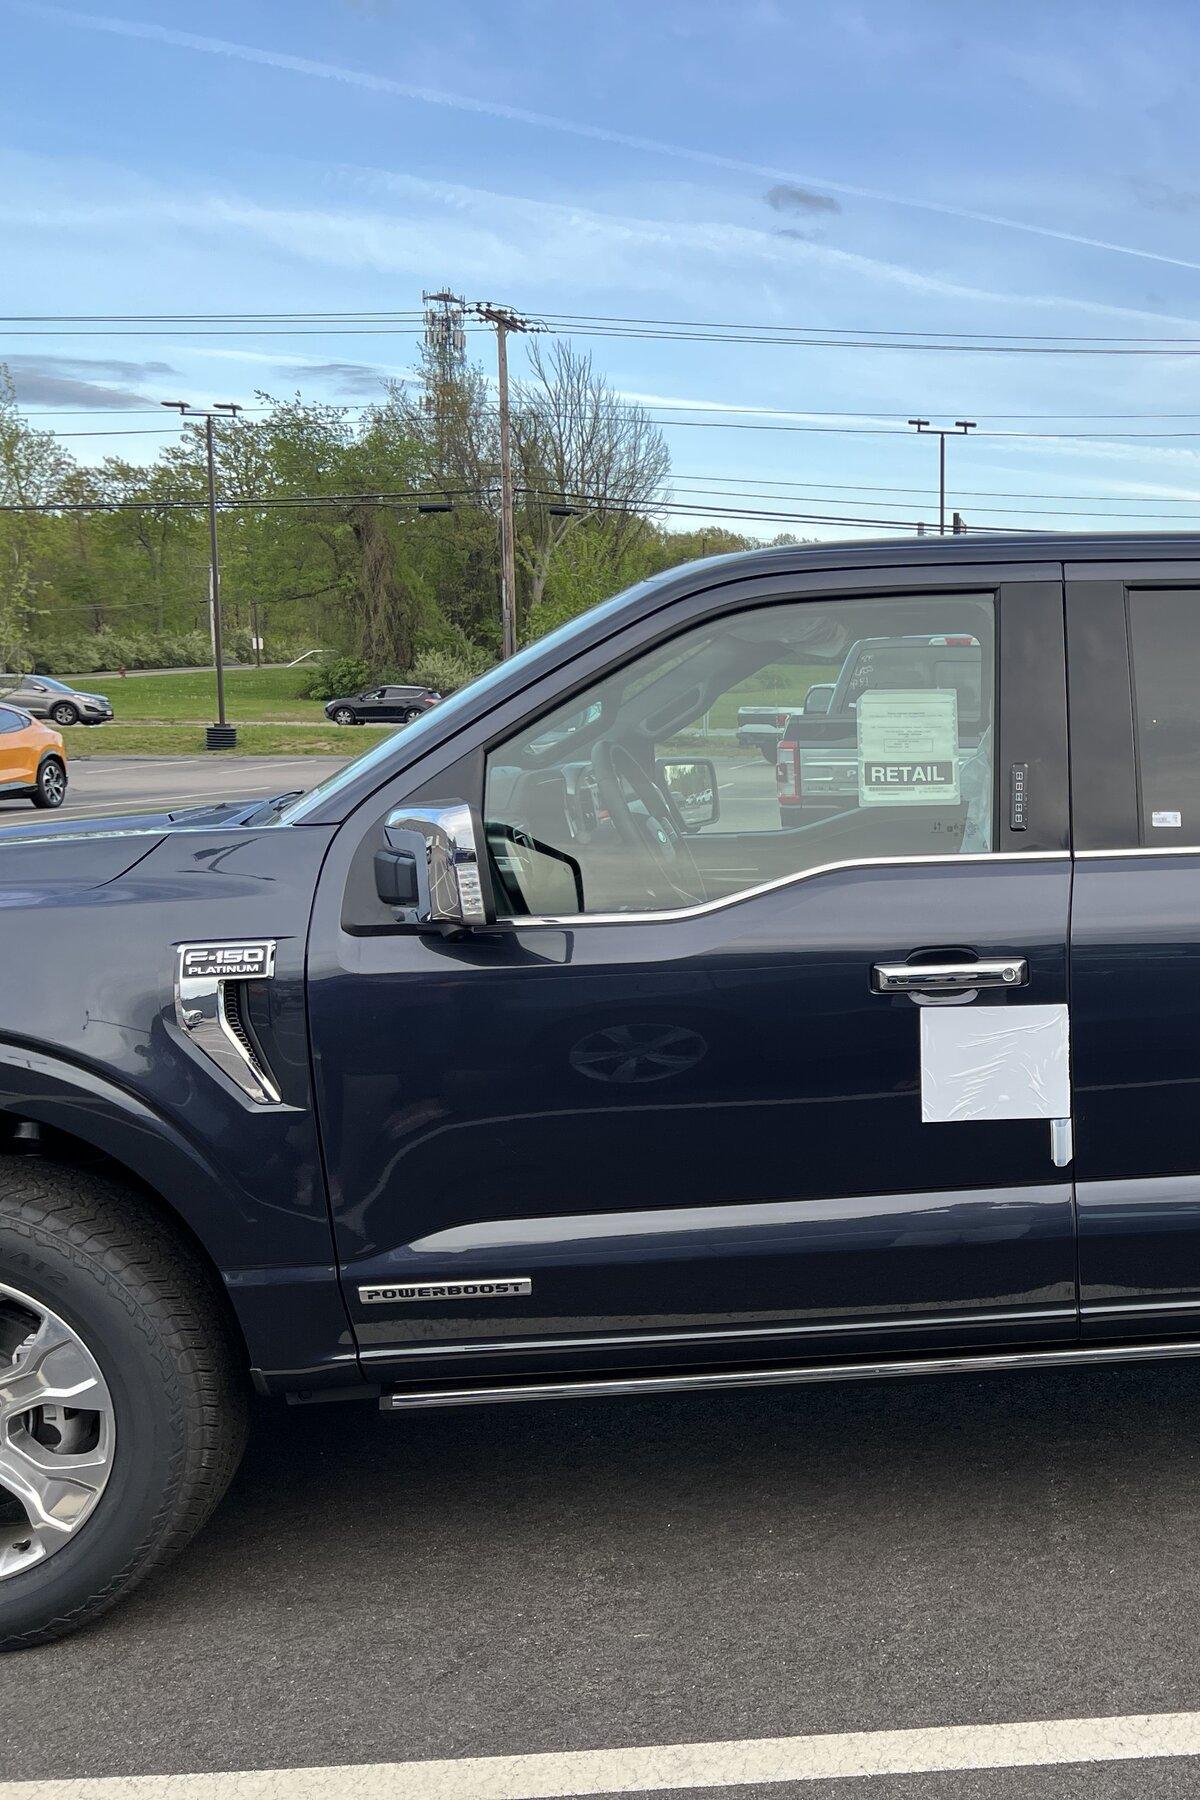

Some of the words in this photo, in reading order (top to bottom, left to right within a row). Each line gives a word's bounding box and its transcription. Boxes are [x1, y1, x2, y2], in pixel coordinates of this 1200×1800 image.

[870, 766, 945, 782] RETAIL
[186, 948, 264, 965] F-150
[188, 965, 259, 975] PLATINUM
[367, 1282, 523, 1300] POWERBOOST
